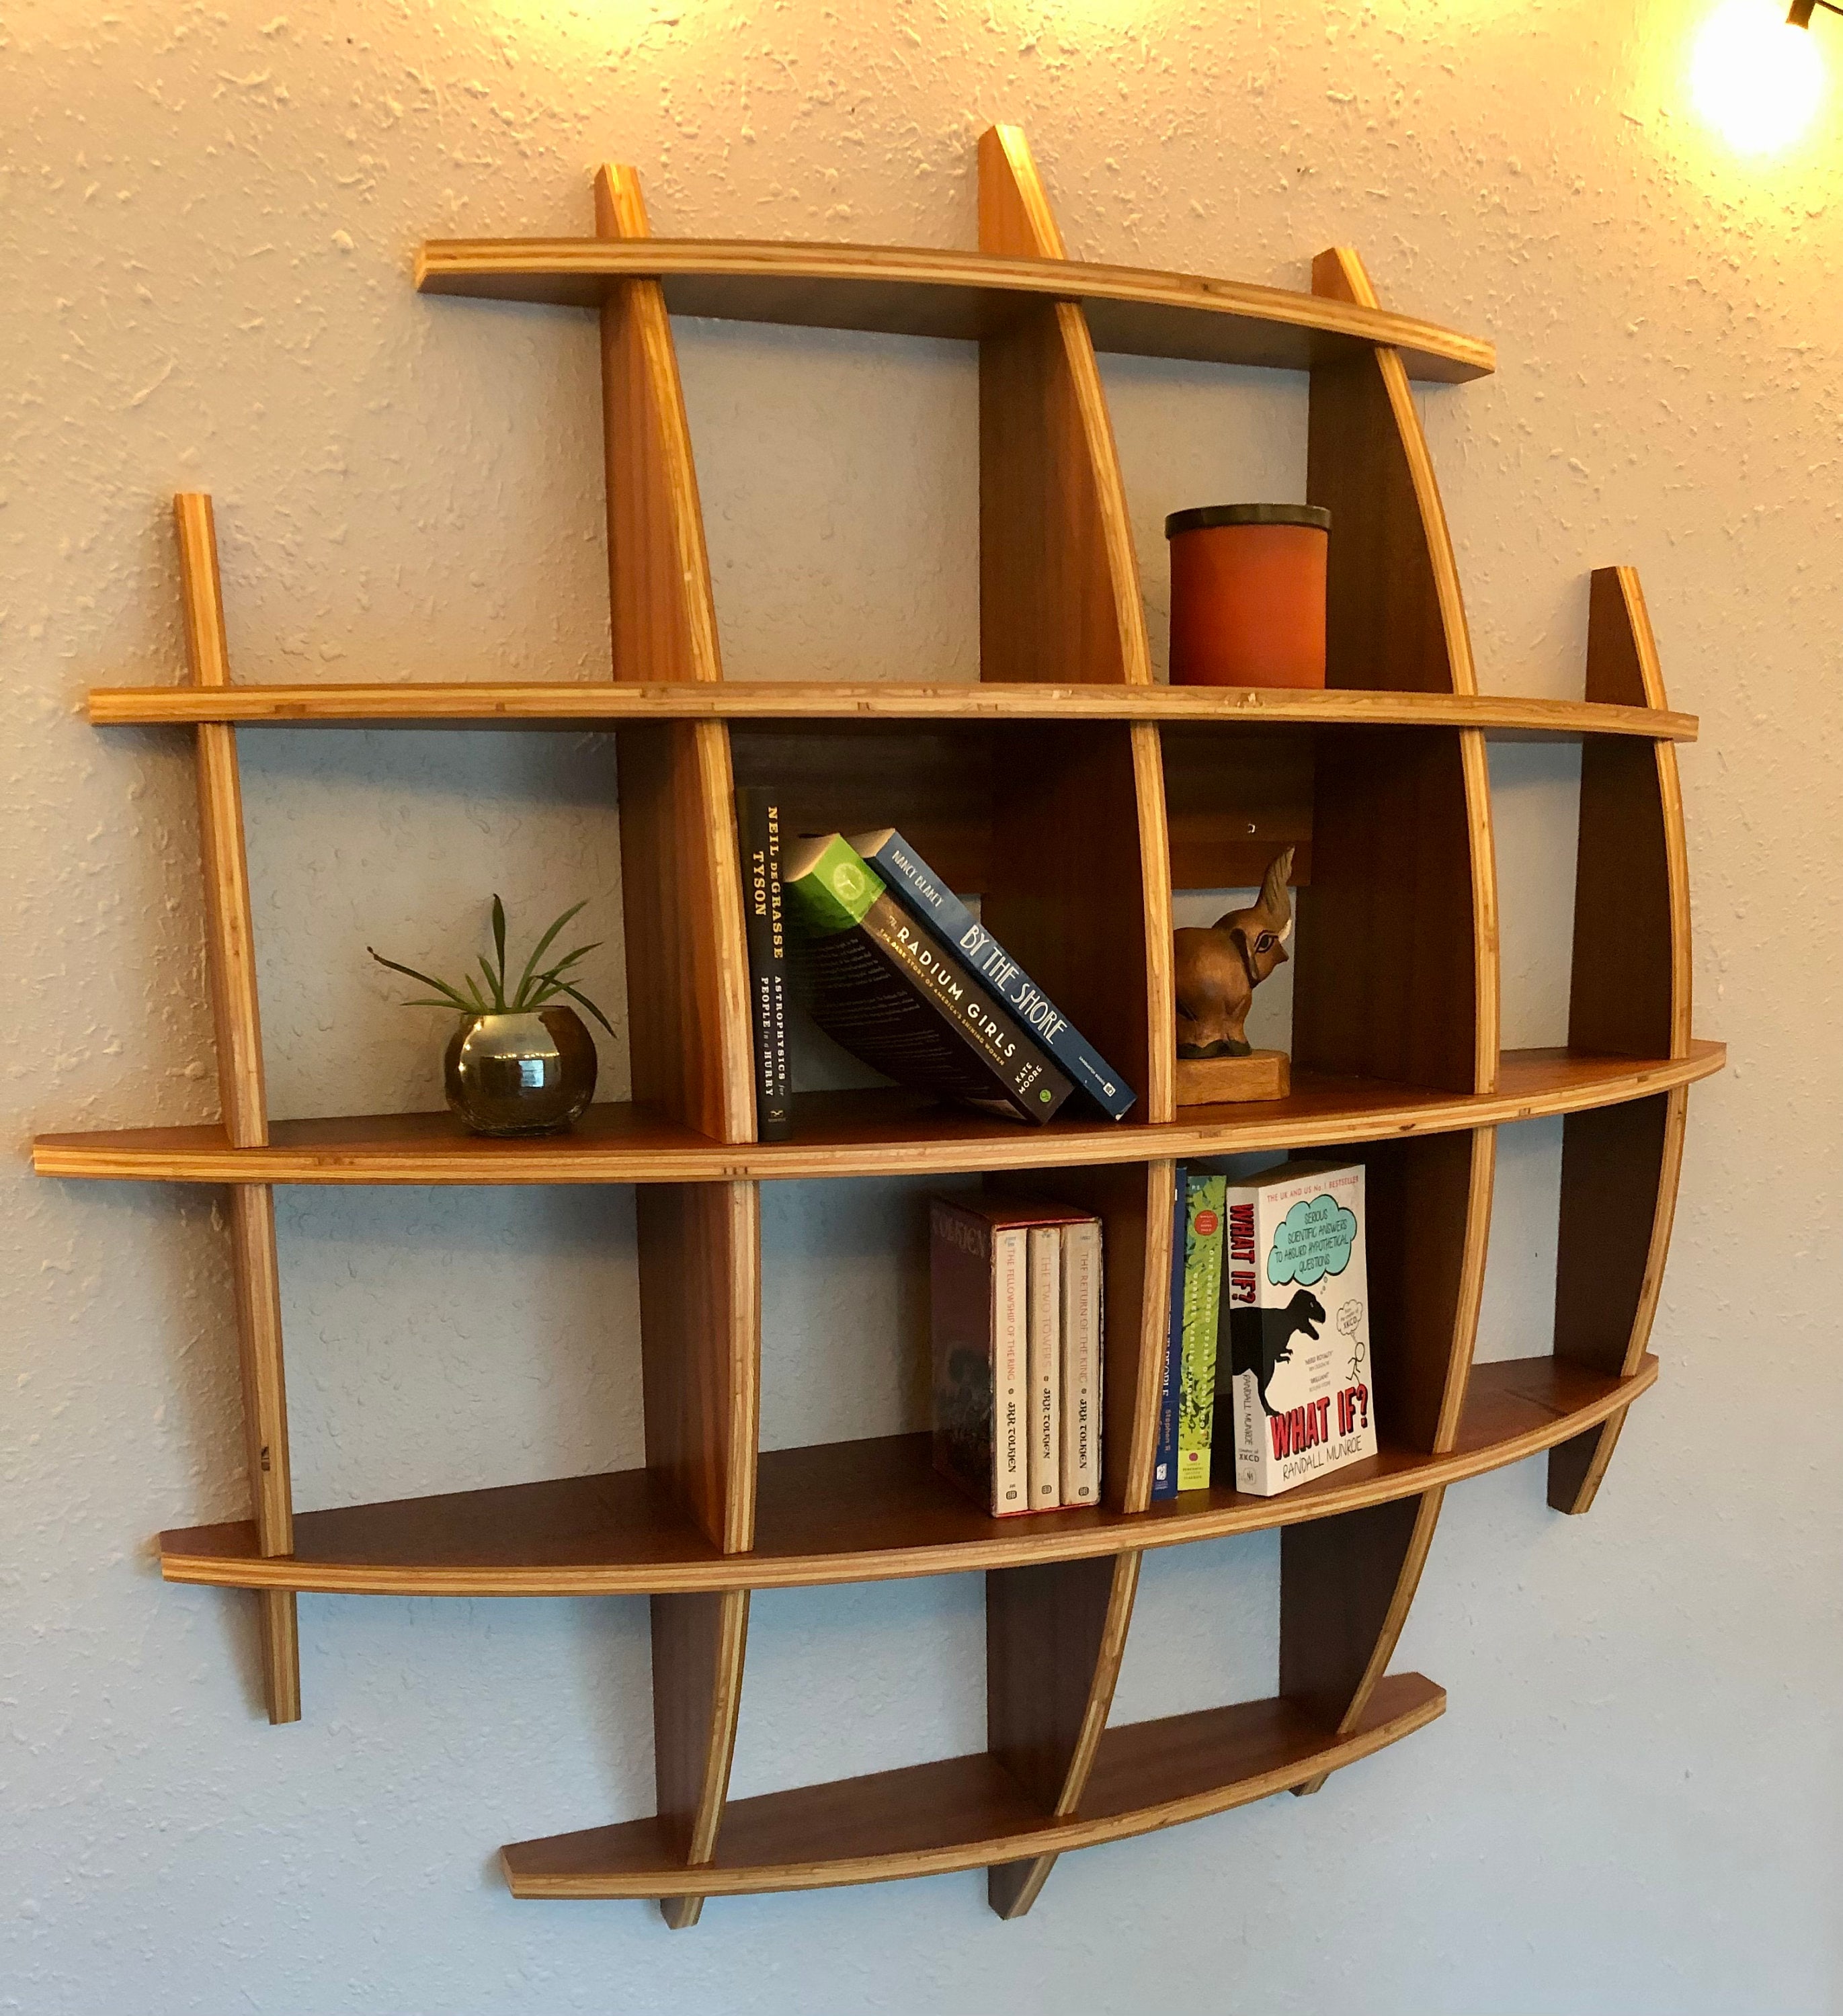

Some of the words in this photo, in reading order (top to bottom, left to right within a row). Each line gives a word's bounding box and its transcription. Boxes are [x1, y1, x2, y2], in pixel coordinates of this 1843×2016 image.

[768, 807, 779, 855] NEIL
[892, 850, 917, 878] NANCY
[753, 851, 766, 915] TYSON
[897, 926, 964, 1001] RADIUM
[967, 1003, 1016, 1057] GIRLS
[960, 924, 989, 956] BY
[982, 946, 1019, 992] THE
[1010, 983, 1067, 1045] SHORE
[761, 977, 771, 1028] PEOPLE
[906, 958, 925, 978] STORY
[961, 1019, 985, 1044] SHINING
[985, 1043, 1005, 1066] WOMEN
[774, 976, 785, 1080] ASTROPHYSICS
[764, 1051, 774, 1096] HURRY
[1015, 1062, 1033, 1083] KATE
[1018, 1064, 1042, 1094] MOORE
[1267, 1193, 1277, 1202] THE
[1280, 1191, 1287, 1200] UK
[1290, 1188, 1302, 1196] AND
[1304, 1186, 1311, 1194] US
[1329, 1175, 1359, 1189] BESTSELLER
[1287, 1226, 1317, 1245] SCIENTIFIC
[1319, 1218, 1348, 1236] ANSWERS
[1305, 1208, 1327, 1224] SERIOUS
[1230, 1203, 1255, 1264] WHAT
[1274, 1251, 1283, 1263] TO
[1284, 1245, 1307, 1261] ABSURD
[1308, 1234, 1349, 1256] HYPOTHETICAL
[1007, 1249, 1015, 1265] THE
[1042, 1257, 1051, 1277] THE
[1080, 1252, 1089, 1271] THE
[1299, 1253, 1330, 1274] QUESTIONS
[1007, 1269, 1015, 1322] FELLOWSHIP
[1042, 1283, 1051, 1313] TWO
[1079, 1275, 1089, 1316] RETURN
[1205, 1275, 1213, 1323] HUNDRED
[1231, 1271, 1256, 1304] IF?
[1008, 1326, 1015, 1337] OF
[1080, 1318, 1088, 1333] OF
[1007, 1340, 1015, 1356] THE
[1042, 1318, 1052, 1368] TOWERS
[1079, 1336, 1088, 1354] THE
[1007, 1359, 1015, 1380] RING
[1079, 1357, 1088, 1383] KING
[1202, 1366, 1208, 1378] OF
[1243, 1374, 1252, 1409] RANDALL
[1042, 1414, 1051, 1459] TOLKIEN
[1243, 1413, 1253, 1445] MUNROE
[1270, 1396, 1330, 1461] WHAT
[1337, 1384, 1368, 1437] IF?
[1008, 1427, 1016, 1473] TOLKIEN
[1079, 1425, 1087, 1469] TOLKIEN
[1239, 1453, 1260, 1462] XKCD
[1283, 1452, 1324, 1482] RANDALL
[1326, 1435, 1362, 1462] MUNROE
